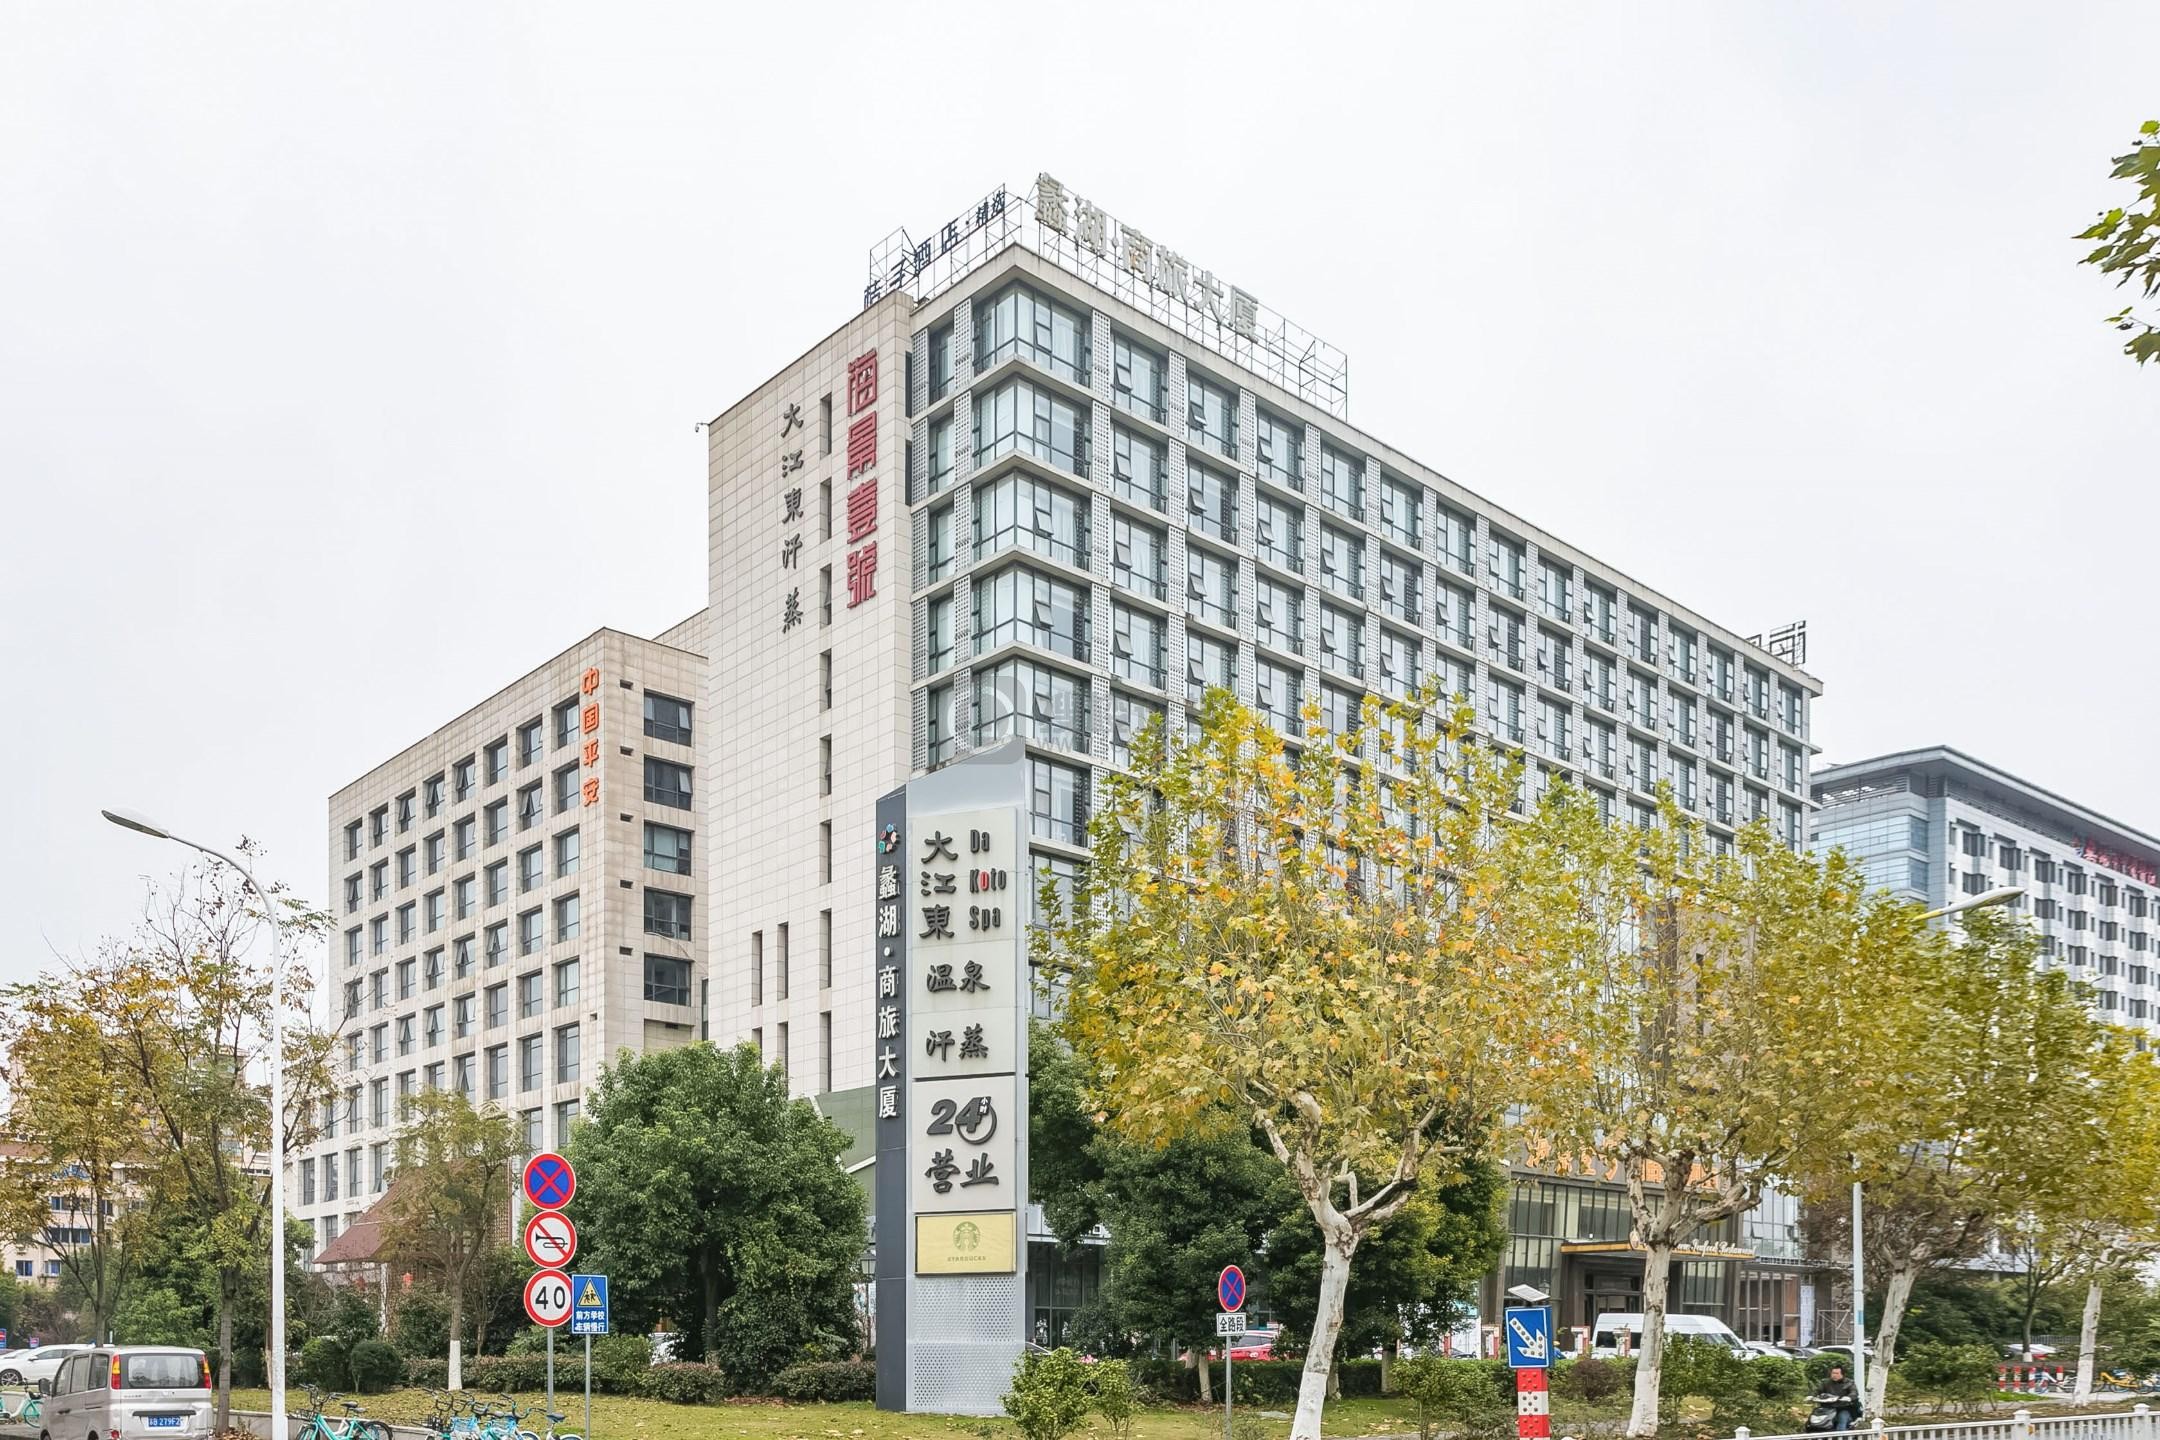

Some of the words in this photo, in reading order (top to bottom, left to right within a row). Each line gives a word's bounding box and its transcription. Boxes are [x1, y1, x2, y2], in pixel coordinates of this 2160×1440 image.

[582, 667, 600, 808] 中国平安
[970, 829, 990, 854] Da
[969, 868, 1007, 894] Koto
[969, 905, 1001, 931] Spa
[926, 960, 991, 993] 温泉
[925, 1023, 989, 1062] 汗蒸
[924, 1148, 1000, 1194] 营业
[535, 1286, 565, 1309] 40
[574, 1322, 605, 1332] 车辆慢行
[576, 1311, 604, 1320] 前方学校
[1220, 1316, 1244, 1332] 全路段
